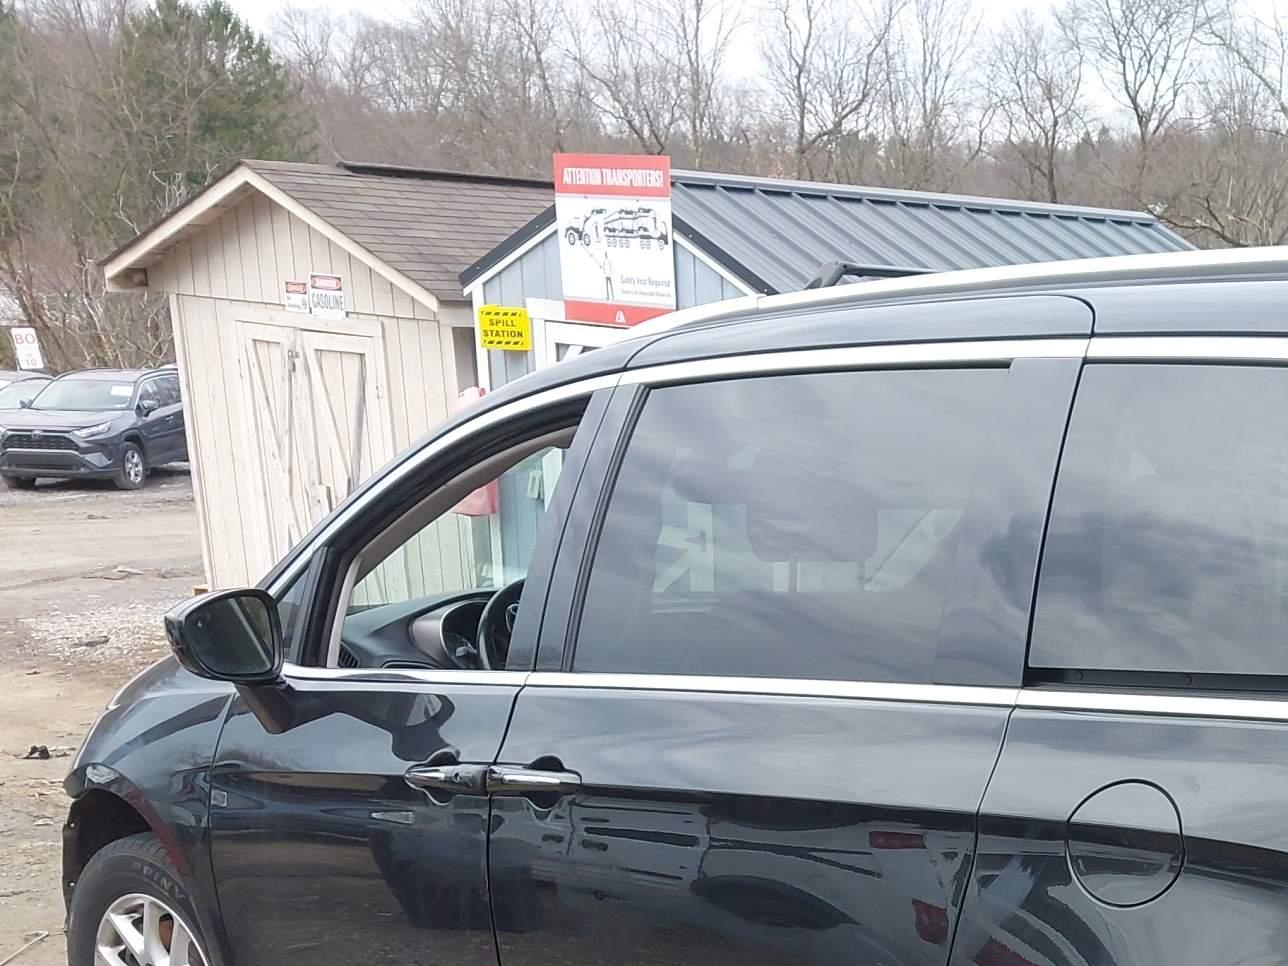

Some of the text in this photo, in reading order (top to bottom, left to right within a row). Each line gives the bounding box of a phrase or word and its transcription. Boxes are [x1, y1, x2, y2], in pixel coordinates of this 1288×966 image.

[563, 167, 664, 188] ATTENTION TRANSPORTERS!
[312, 292, 344, 311] GASOLINE
[488, 318, 517, 328] SPILL
[482, 329, 524, 339] STATION
